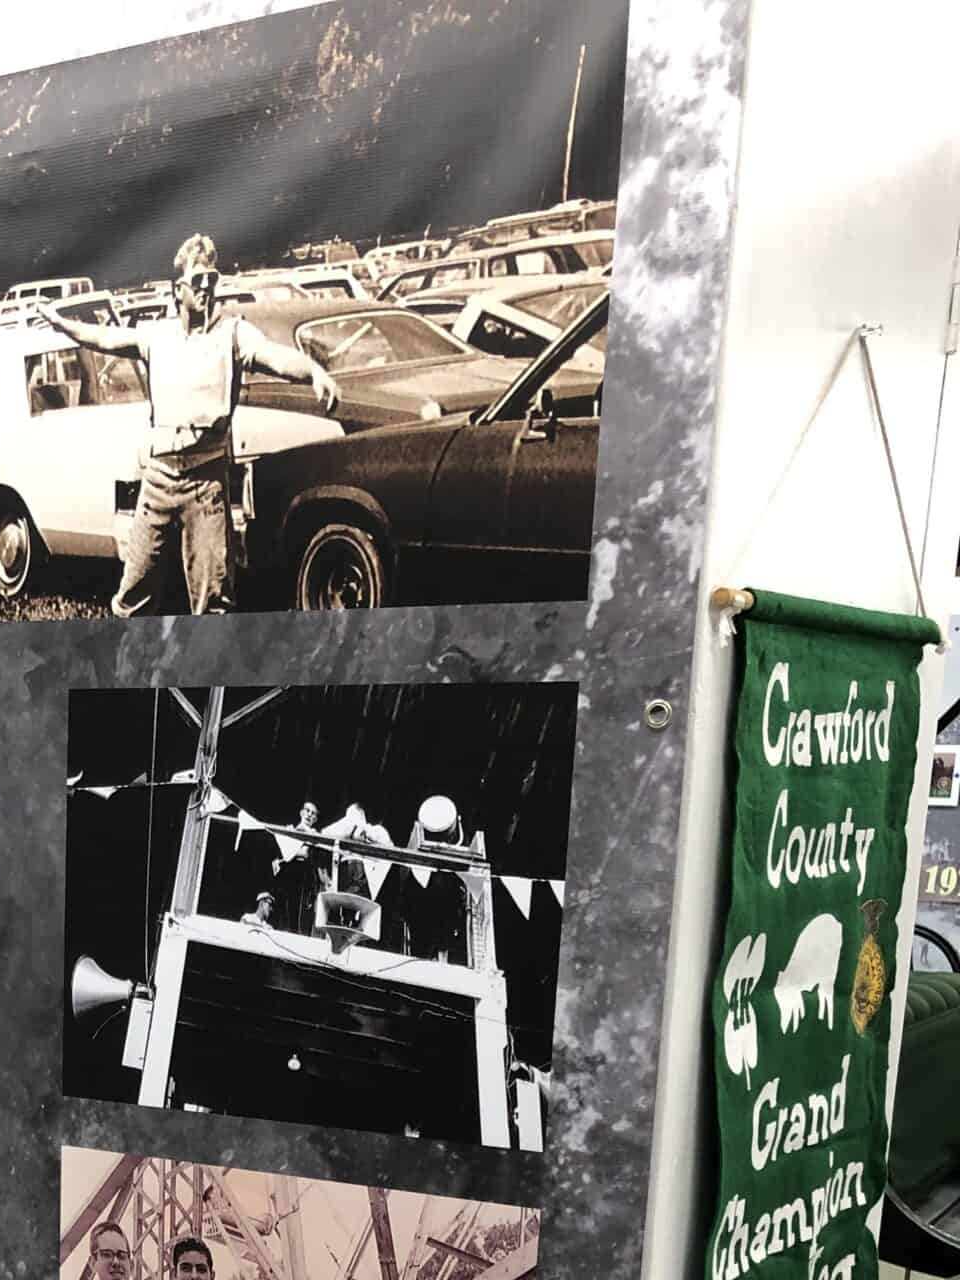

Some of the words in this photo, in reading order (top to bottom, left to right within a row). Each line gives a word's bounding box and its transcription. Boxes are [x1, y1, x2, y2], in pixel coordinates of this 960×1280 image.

[762, 661, 896, 767] Crawford
[766, 789, 875, 895] County
[751, 1055, 851, 1171] Grand
